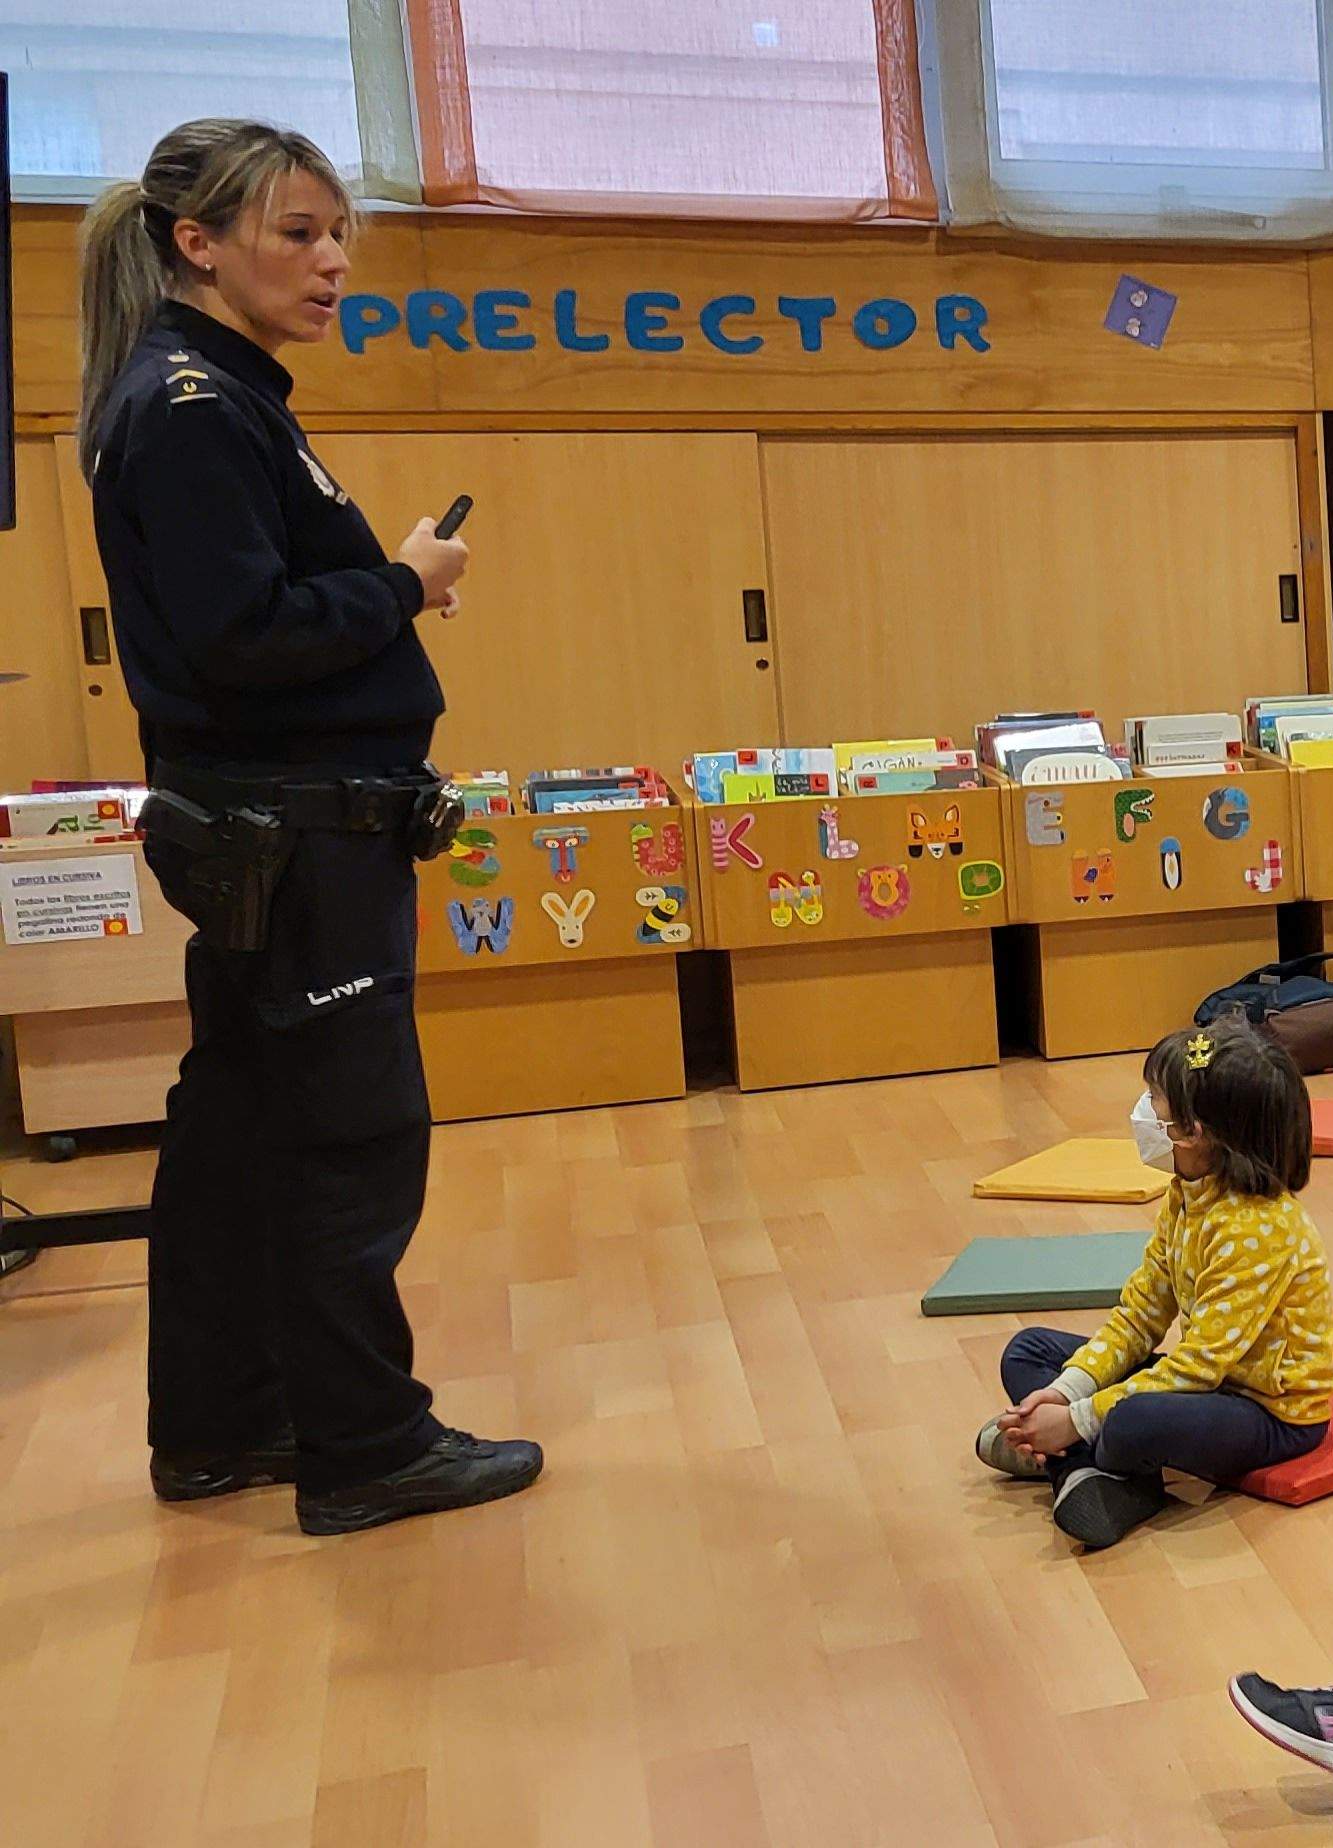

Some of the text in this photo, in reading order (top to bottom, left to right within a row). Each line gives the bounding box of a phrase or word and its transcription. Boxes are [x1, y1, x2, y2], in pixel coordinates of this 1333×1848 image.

[339, 289, 992, 354] PRELECTOR
[817, 803, 859, 860] L
[1025, 791, 1066, 845] E
[1113, 788, 1154, 843] F
[1202, 787, 1250, 840] G
[532, 826, 591, 884] T
[630, 821, 685, 876] U
[711, 812, 763, 874] K
[12, 871, 103, 887] LIBROS EN CURSIVA
[48, 924, 100, 935] AMARILLO
